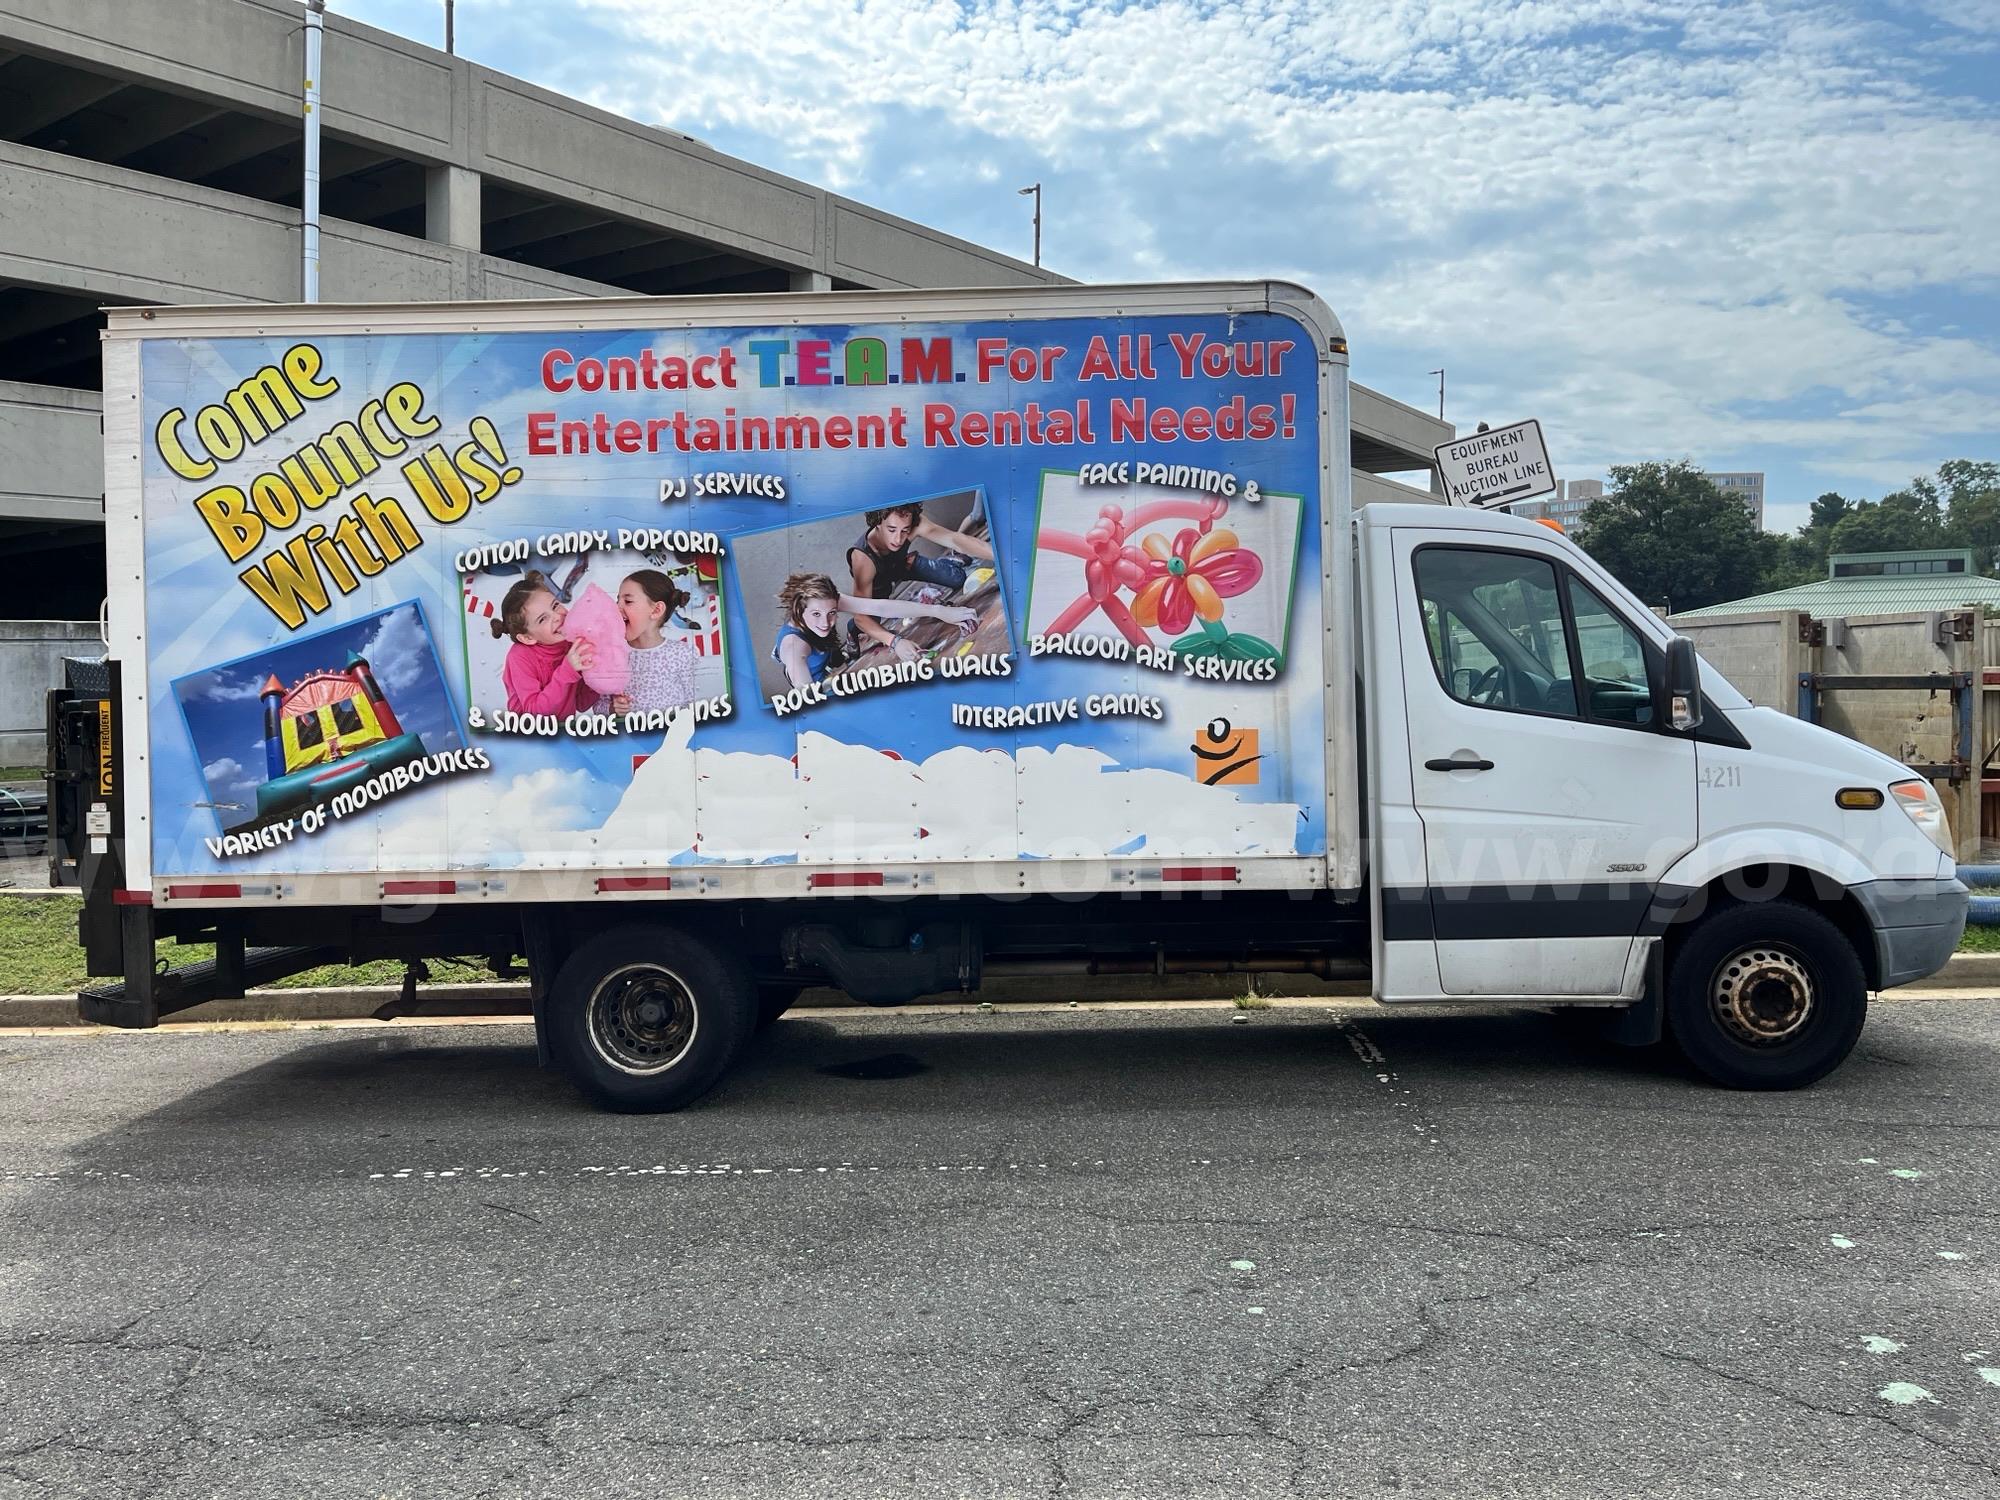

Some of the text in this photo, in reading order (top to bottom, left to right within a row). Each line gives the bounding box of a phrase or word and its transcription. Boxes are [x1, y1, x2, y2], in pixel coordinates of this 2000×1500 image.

[541, 332, 1296, 394] Contact T.E.A.M. For All Your
[155, 343, 341, 481] Come
[526, 393, 1297, 457] Entertainment Rental Needs!
[193, 382, 442, 564] Bounce
[1078, 461, 1261, 502] FACE PAINTING &
[1453, 461, 1545, 498] AUCTION LINE
[1466, 450, 1519, 476] BUREAU
[659, 471, 786, 502] DJ SERVICES
[238, 416, 523, 631] With Us!
[455, 528, 726, 572] COTTON CANDY, POPCORN,
[1030, 633, 1277, 682] BALLOON ART SERVICES
[772, 653, 1012, 717] ROCK CLIMBING WALLS
[468, 693, 732, 737] & SNOW CONE MACNES
[952, 693, 1164, 729] INTERACTIVE GAMES
[1698, 766, 1741, 787] 4211
[205, 747, 490, 859] VARIETY OF MOONBOUNCES
